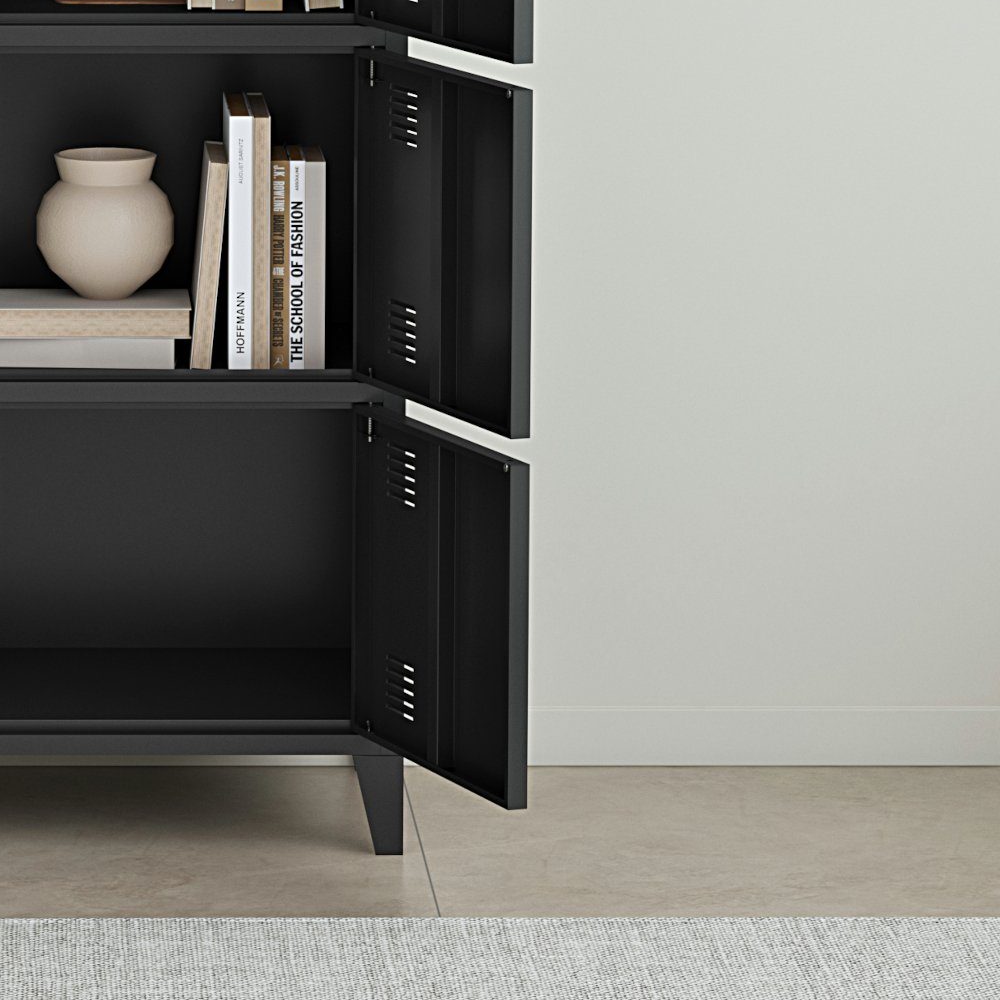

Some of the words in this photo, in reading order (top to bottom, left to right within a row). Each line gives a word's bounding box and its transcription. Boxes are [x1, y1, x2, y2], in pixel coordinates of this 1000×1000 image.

[273, 164, 285, 179] J.K.
[273, 180, 285, 212] ROWLING
[273, 214, 284, 238] HARRY
[290, 201, 303, 257] FASHION
[273, 239, 284, 265] POTTER
[290, 260, 303, 278] OF
[272, 278, 284, 311] CHAMBER
[290, 281, 303, 334] SCHOOL
[236, 292, 245, 354] HOFFMANN
[272, 318, 284, 347] SECRETS
[290, 337, 303, 362] THE
